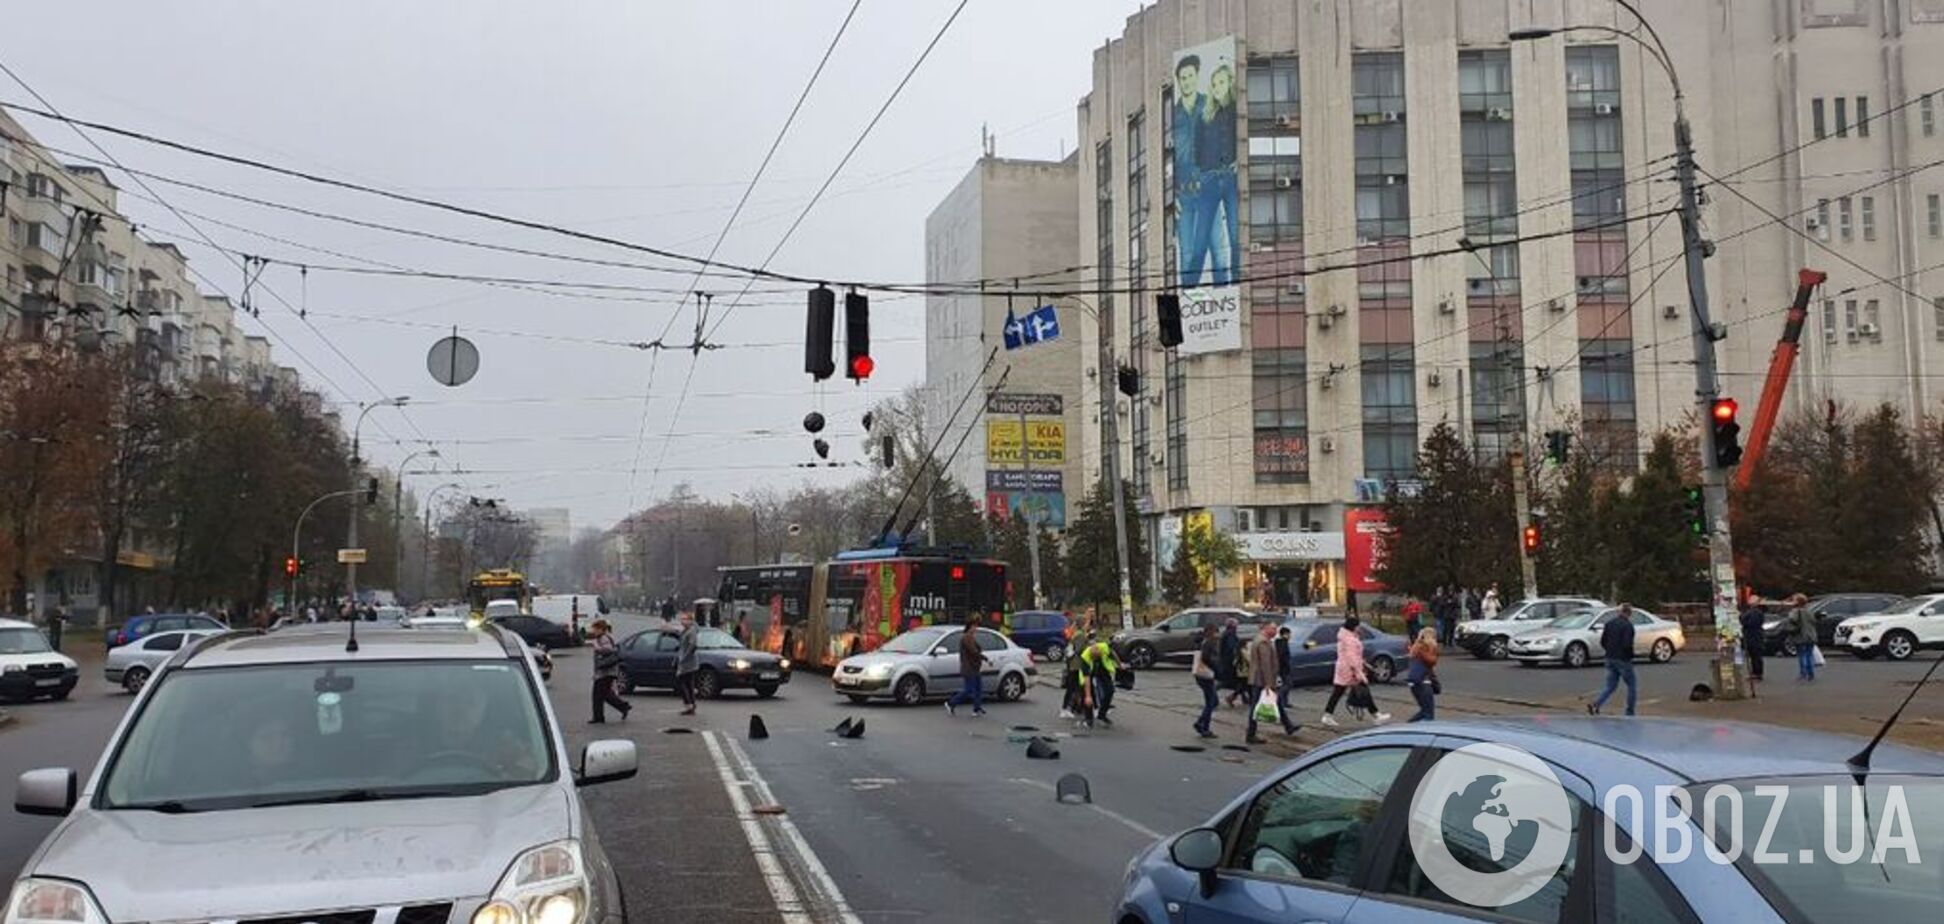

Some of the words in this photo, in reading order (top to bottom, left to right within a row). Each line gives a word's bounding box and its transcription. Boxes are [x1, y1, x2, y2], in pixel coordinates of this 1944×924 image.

[1180, 297, 1237, 319] COLIN'S
[1188, 319, 1229, 334] OUTLET
[1036, 425, 1062, 439] KIA
[910, 592, 946, 610] min
